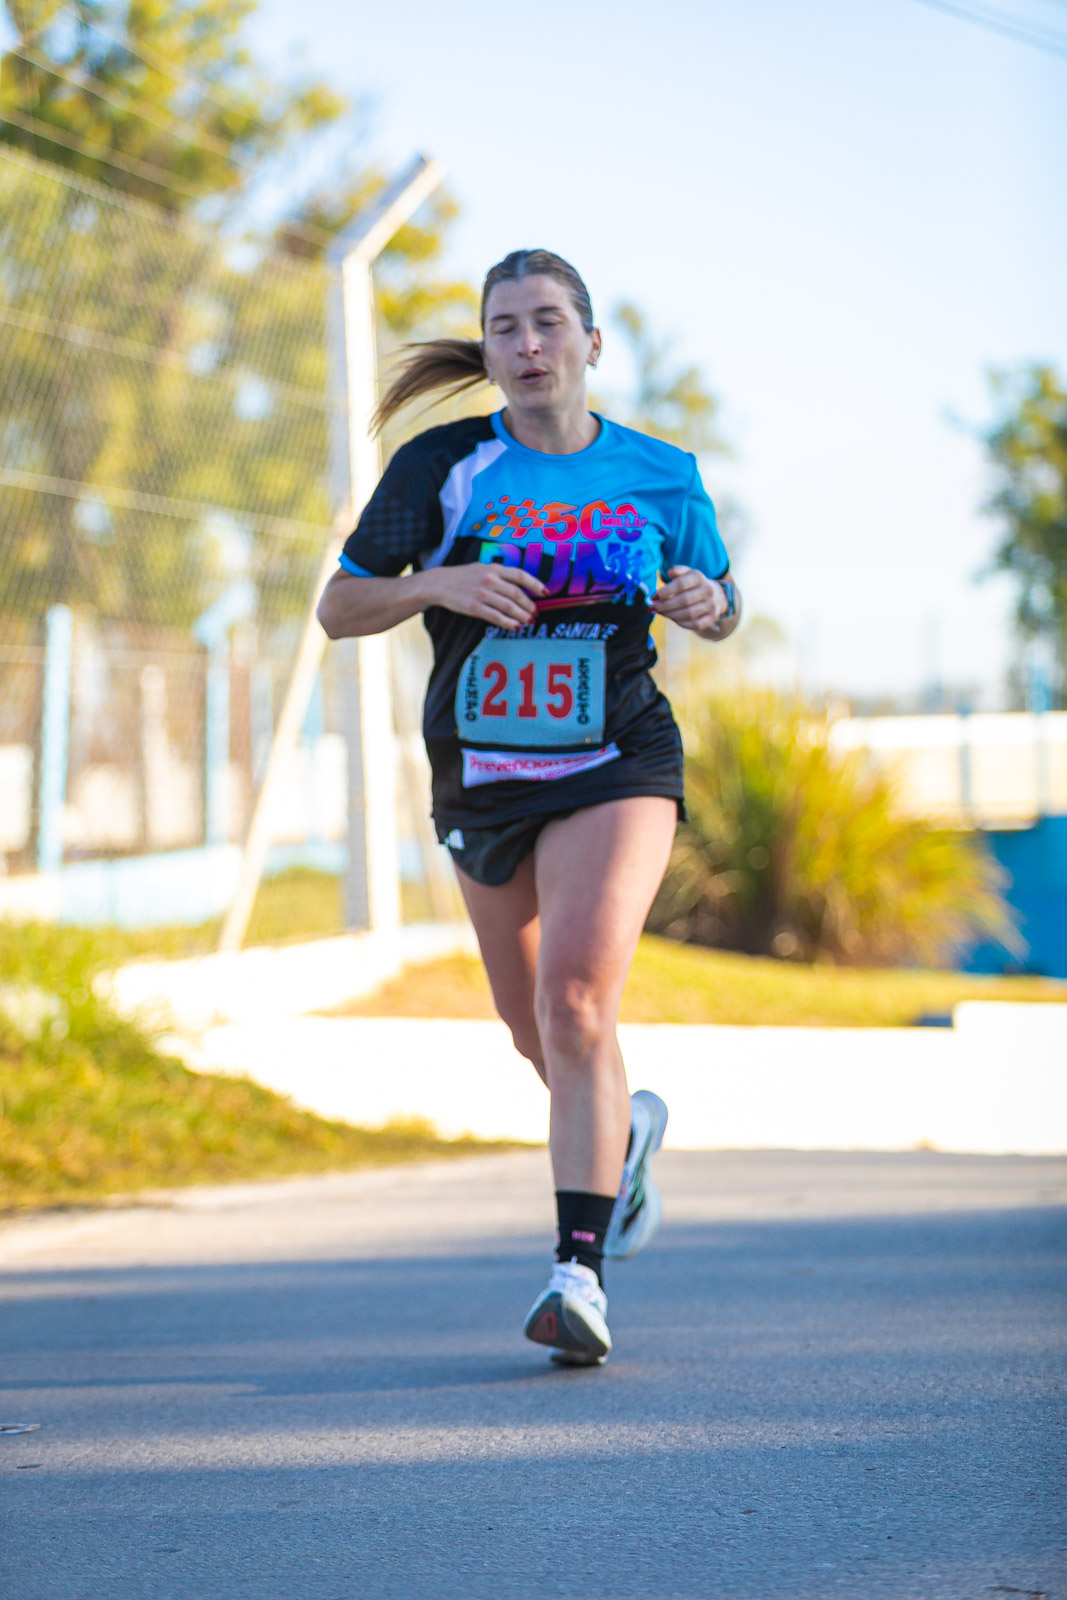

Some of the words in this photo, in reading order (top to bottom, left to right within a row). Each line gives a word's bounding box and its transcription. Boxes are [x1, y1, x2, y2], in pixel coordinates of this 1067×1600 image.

[465, 656, 479, 722] TIEMPO
[481, 661, 574, 720] 215
[577, 657, 590, 724] EXACTO
